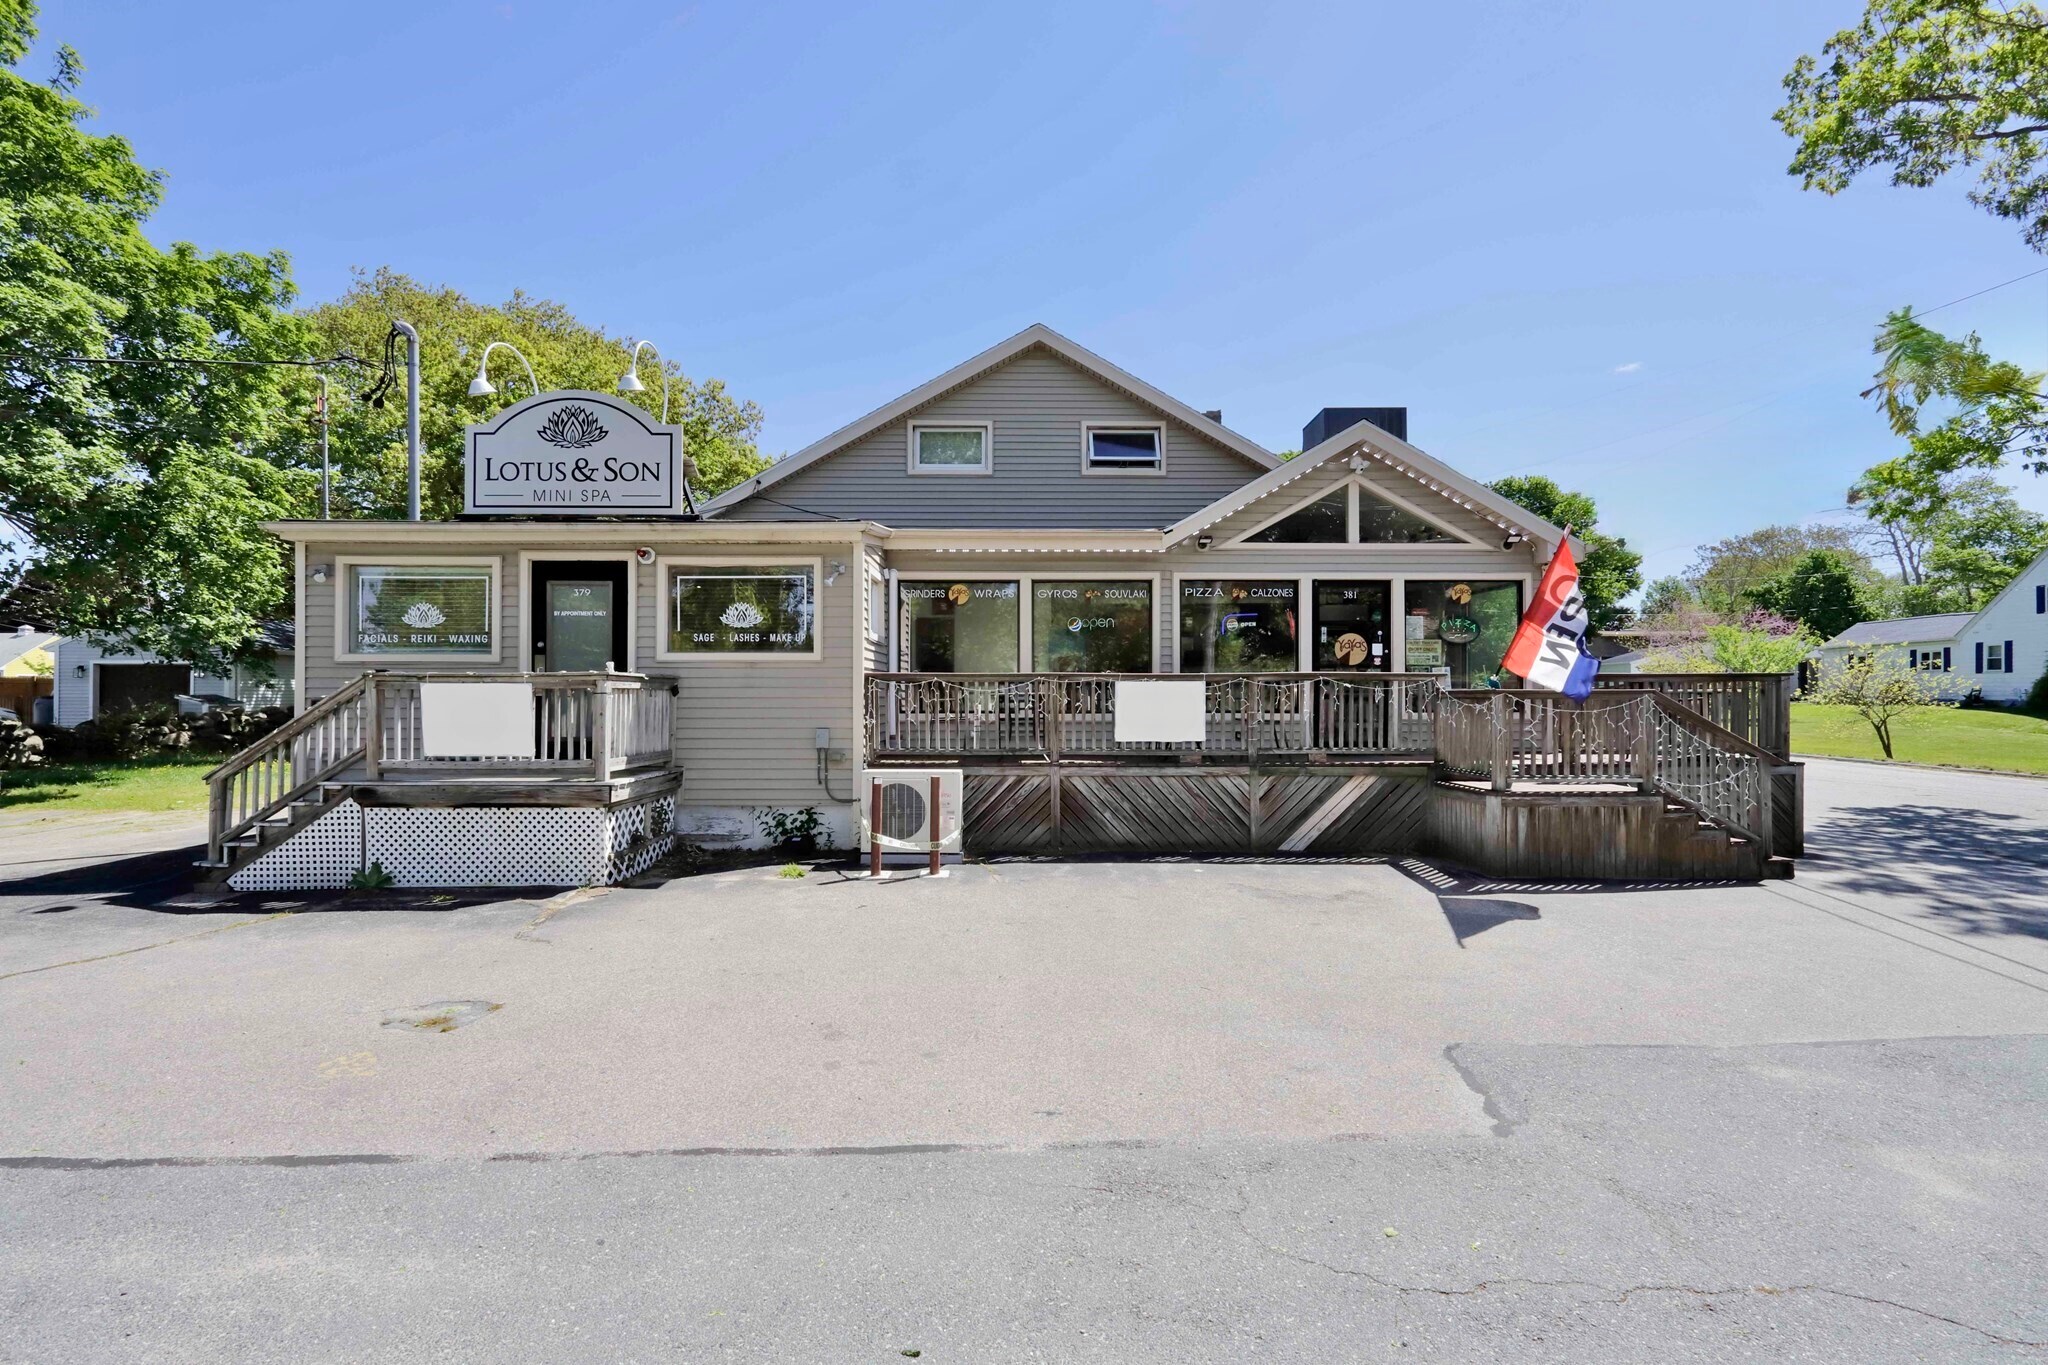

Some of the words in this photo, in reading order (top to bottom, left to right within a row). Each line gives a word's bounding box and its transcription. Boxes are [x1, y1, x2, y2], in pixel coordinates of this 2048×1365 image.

[484, 457, 567, 482] LOTUS
[571, 457, 599, 482] &
[603, 457, 661, 482] SON
[533, 489, 572, 502] MINI
[581, 489, 612, 502] SPA
[573, 588, 591, 597] 379
[905, 589, 946, 598] GRINDERS
[973, 589, 1015, 598] WRAPS
[1037, 589, 1078, 599] GYROS
[1104, 589, 1147, 599] SOUVLAKI
[1184, 587, 1224, 597] PIZZA
[1250, 588, 1294, 598] CALZONES
[1343, 590, 1357, 599] 381
[1082, 617, 1115, 631] open
[358, 634, 399, 643] FACIALS
[410, 634, 437, 643] REIKI
[449, 634, 488, 643] WAXING
[693, 633, 715, 642] SAGE
[729, 633, 760, 642] LASHES
[769, 633, 793, 642] MAKE
[795, 633, 806, 642] UP
